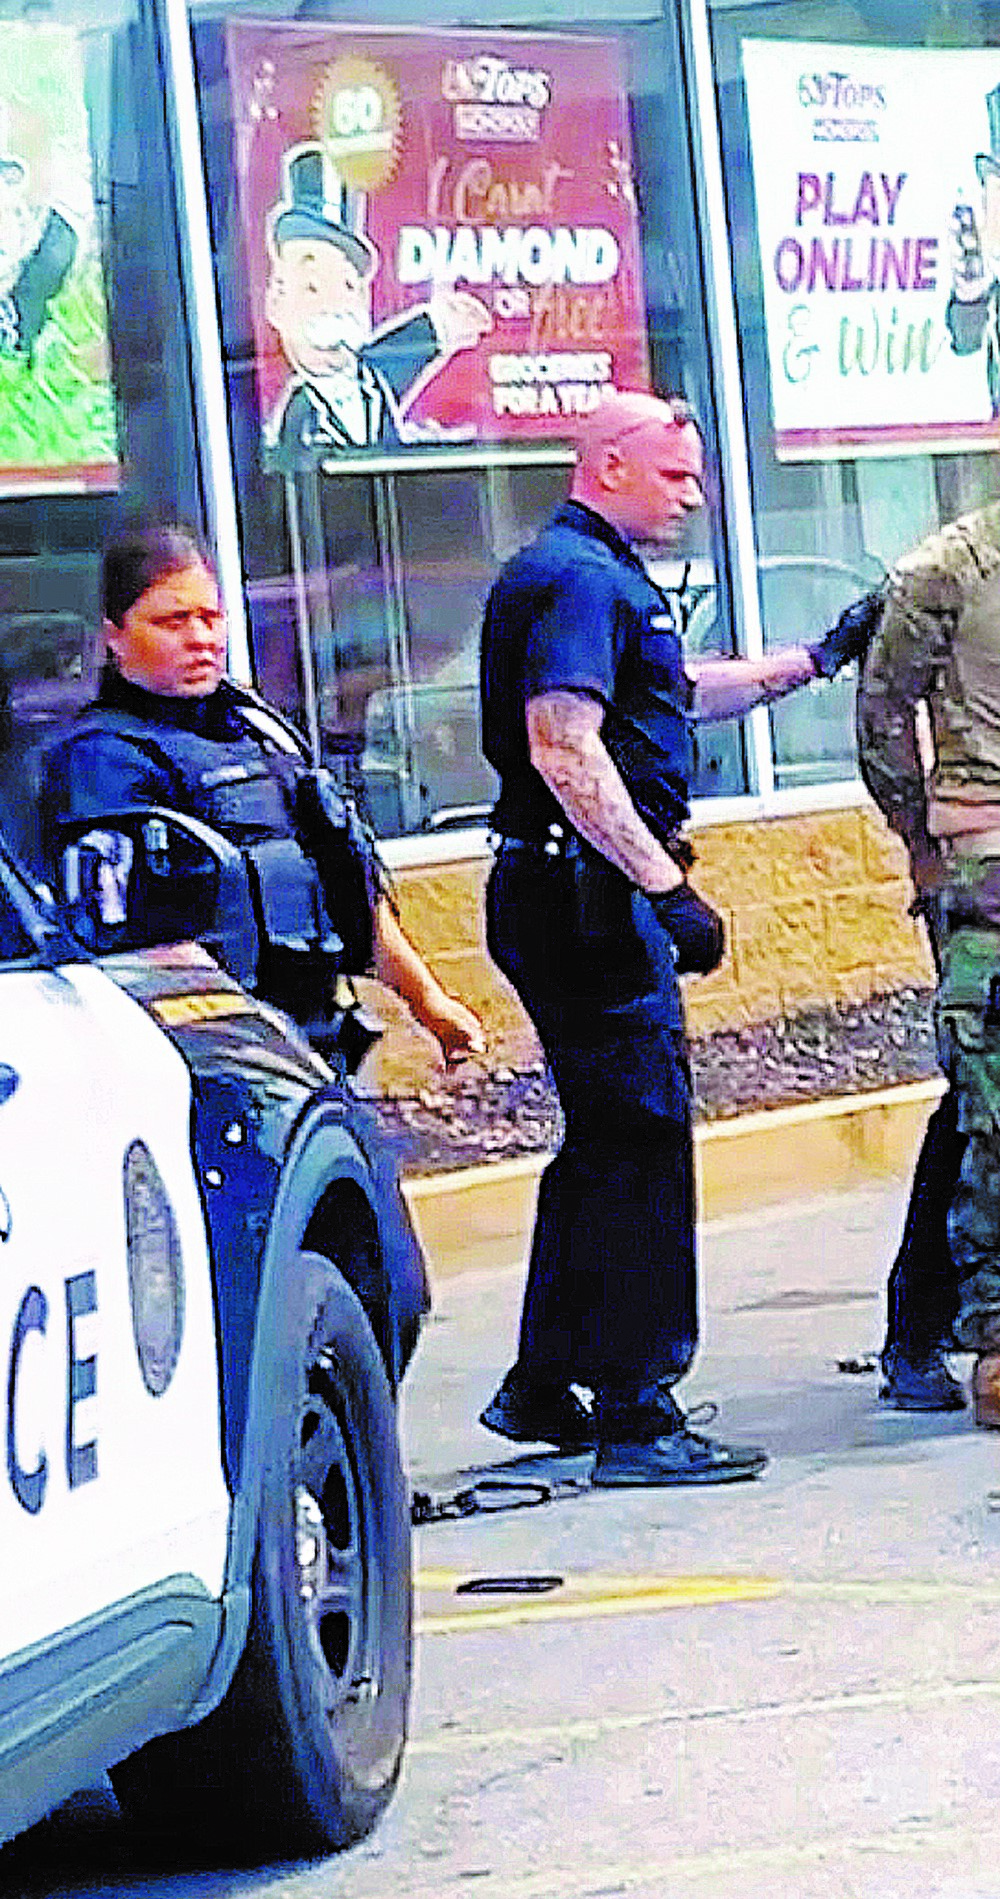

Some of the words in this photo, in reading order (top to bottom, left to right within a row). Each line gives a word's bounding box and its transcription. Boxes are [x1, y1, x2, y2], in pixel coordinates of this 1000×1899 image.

[796, 171, 908, 226] PLAY
[398, 225, 620, 285] DIAMOND
[774, 236, 938, 293] ONLINE
[838, 304, 946, 377] Win
